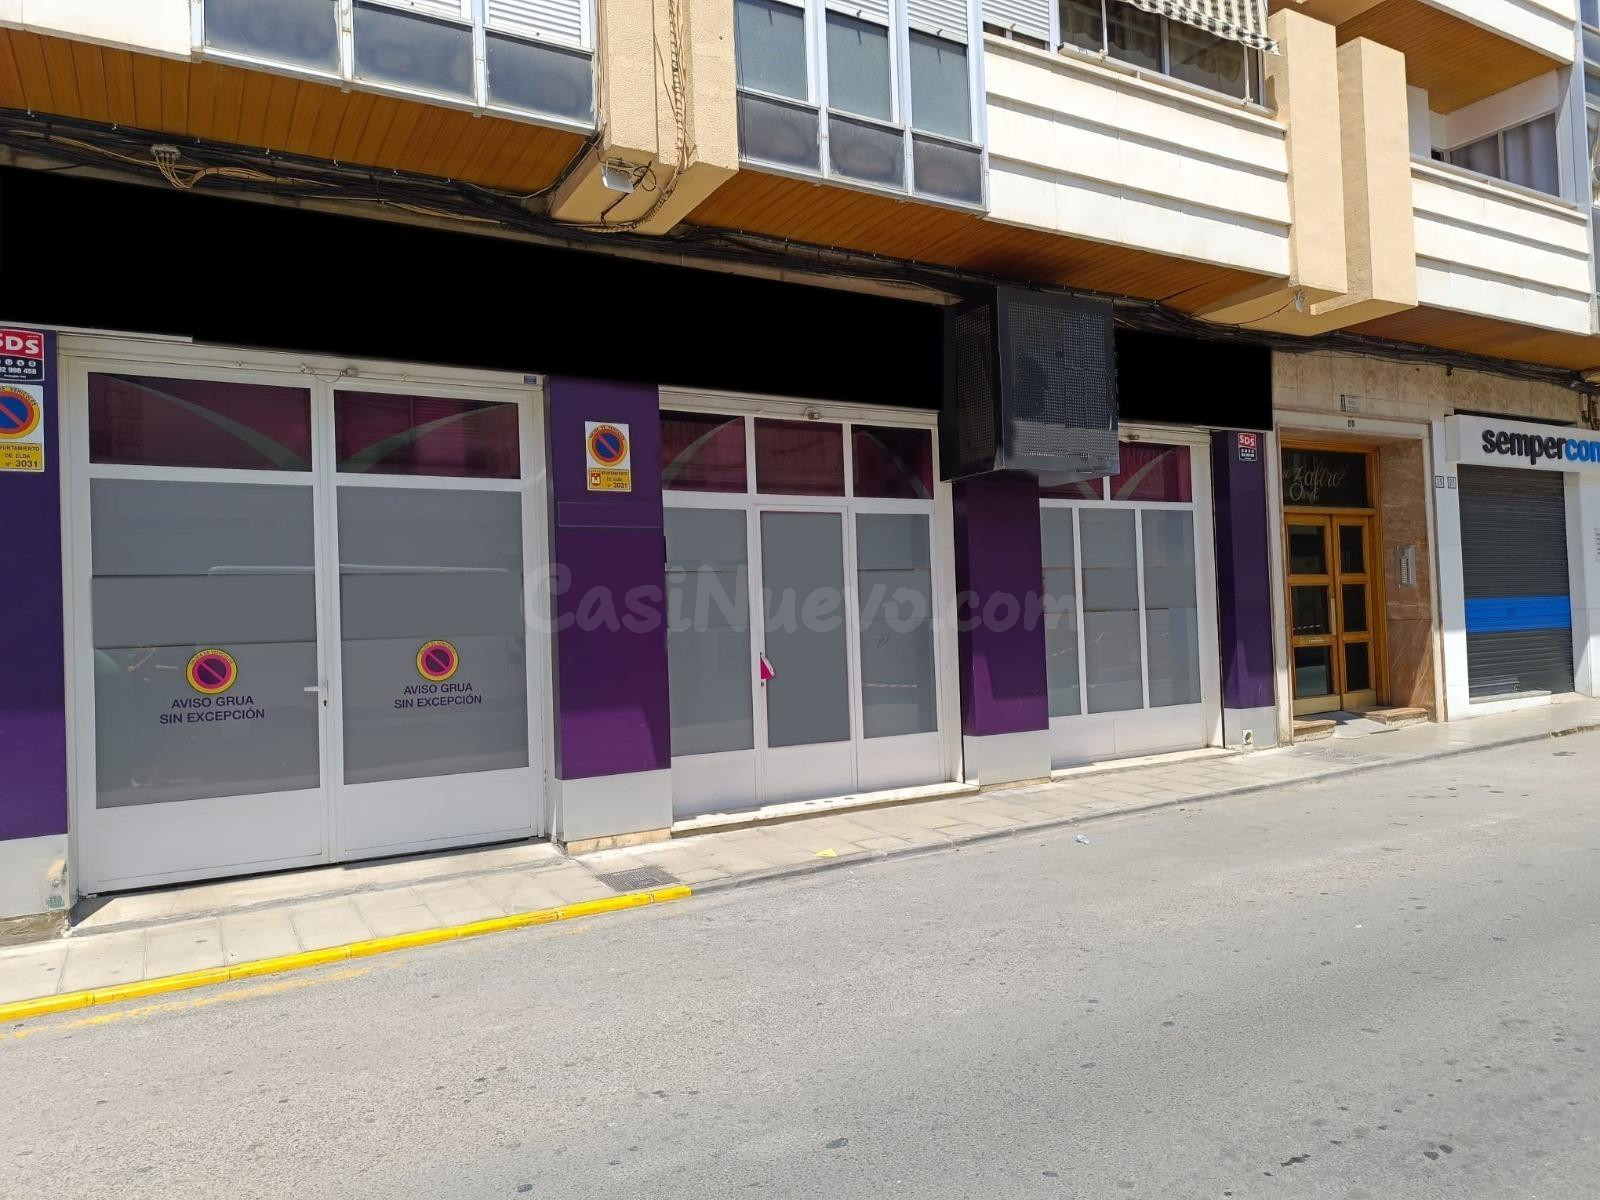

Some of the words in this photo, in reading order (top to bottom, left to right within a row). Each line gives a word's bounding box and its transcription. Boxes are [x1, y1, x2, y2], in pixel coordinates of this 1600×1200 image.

[0, 332, 39, 354] DS
[1239, 434, 1255, 447] SDS
[15, 460, 38, 468] 3031
[404, 684, 437, 695] AVISO
[441, 682, 473, 693] GRUA
[172, 697, 211, 709] AVISO
[216, 695, 254, 707] GRUA
[394, 699, 413, 709] SIN
[416, 695, 482, 708] EXCEPCIÓN
[160, 714, 183, 725] SIN
[187, 708, 265, 724] EXCEPCIÓN
